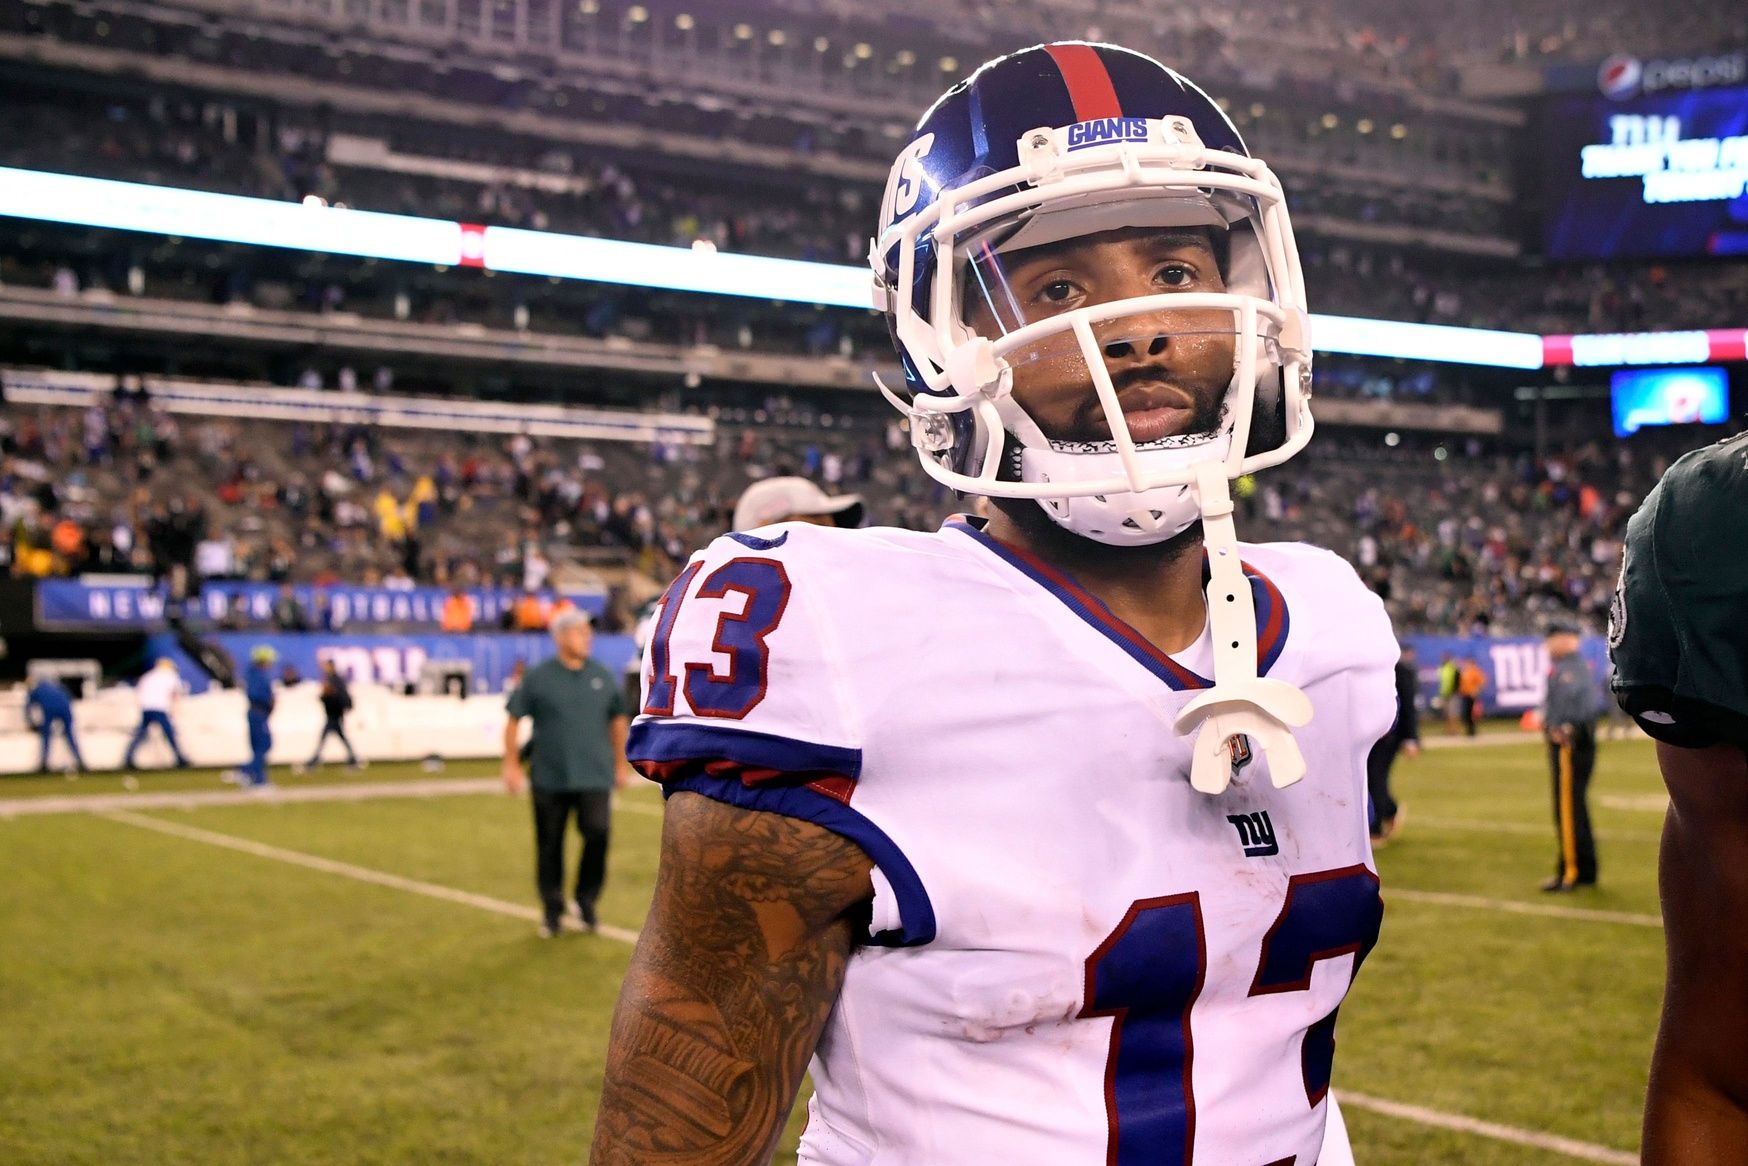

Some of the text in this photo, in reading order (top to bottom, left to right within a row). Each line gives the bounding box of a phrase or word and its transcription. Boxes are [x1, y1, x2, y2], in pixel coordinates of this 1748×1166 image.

[1642, 57, 1745, 91] pepsi
[1067, 117, 1148, 148] GIANTS
[88, 589, 165, 621] NEW
[643, 557, 792, 720] 13
[1077, 863, 1384, 1166] 13
